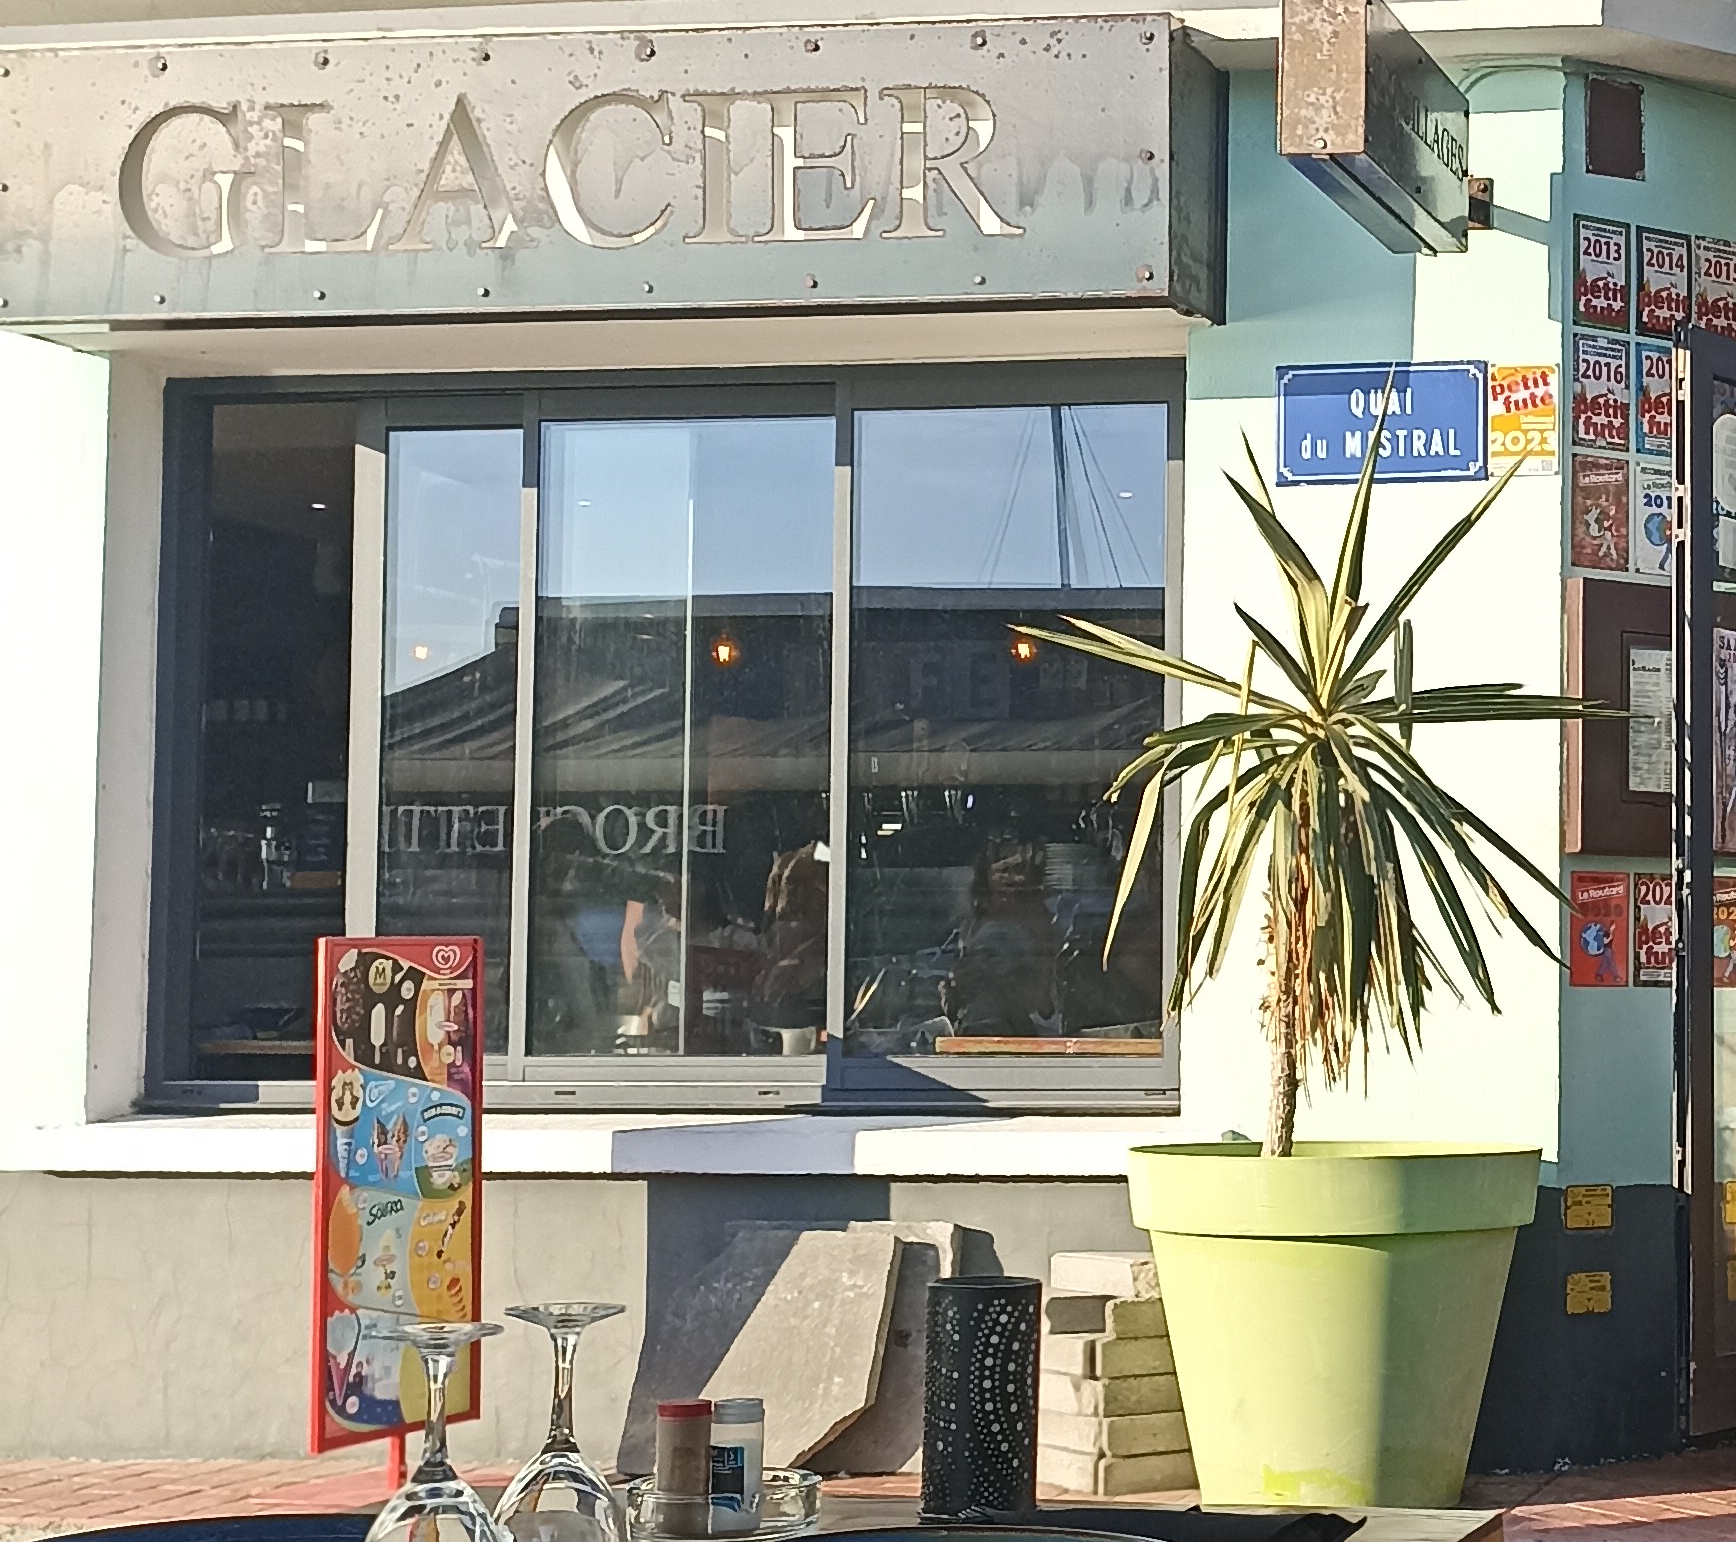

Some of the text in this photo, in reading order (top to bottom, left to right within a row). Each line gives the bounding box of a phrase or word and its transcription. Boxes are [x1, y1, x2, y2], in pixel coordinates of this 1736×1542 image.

[117, 84, 1026, 259] GLACIER
[1582, 236, 1622, 262] 2013
[1646, 248, 1686, 273] 2014
[1576, 277, 1627, 304] petit
[1639, 287, 1690, 314] petit
[1581, 358, 1624, 384] 2016
[1645, 355, 1672, 379] 201
[1490, 370, 1551, 396] petit
[1350, 388, 1412, 418] QUAI
[1502, 389, 1555, 414] futé
[1574, 393, 1629, 419] petit
[1491, 430, 1557, 453] 2023
[1583, 419, 1629, 440] futé
[1301, 434, 1328, 459] du
[1652, 480, 1672, 489] Rout
[1643, 492, 1672, 510] 201
[1578, 884, 1624, 900] Le Routard
[1638, 880, 1672, 906] 202
[1636, 923, 1672, 950] pet
